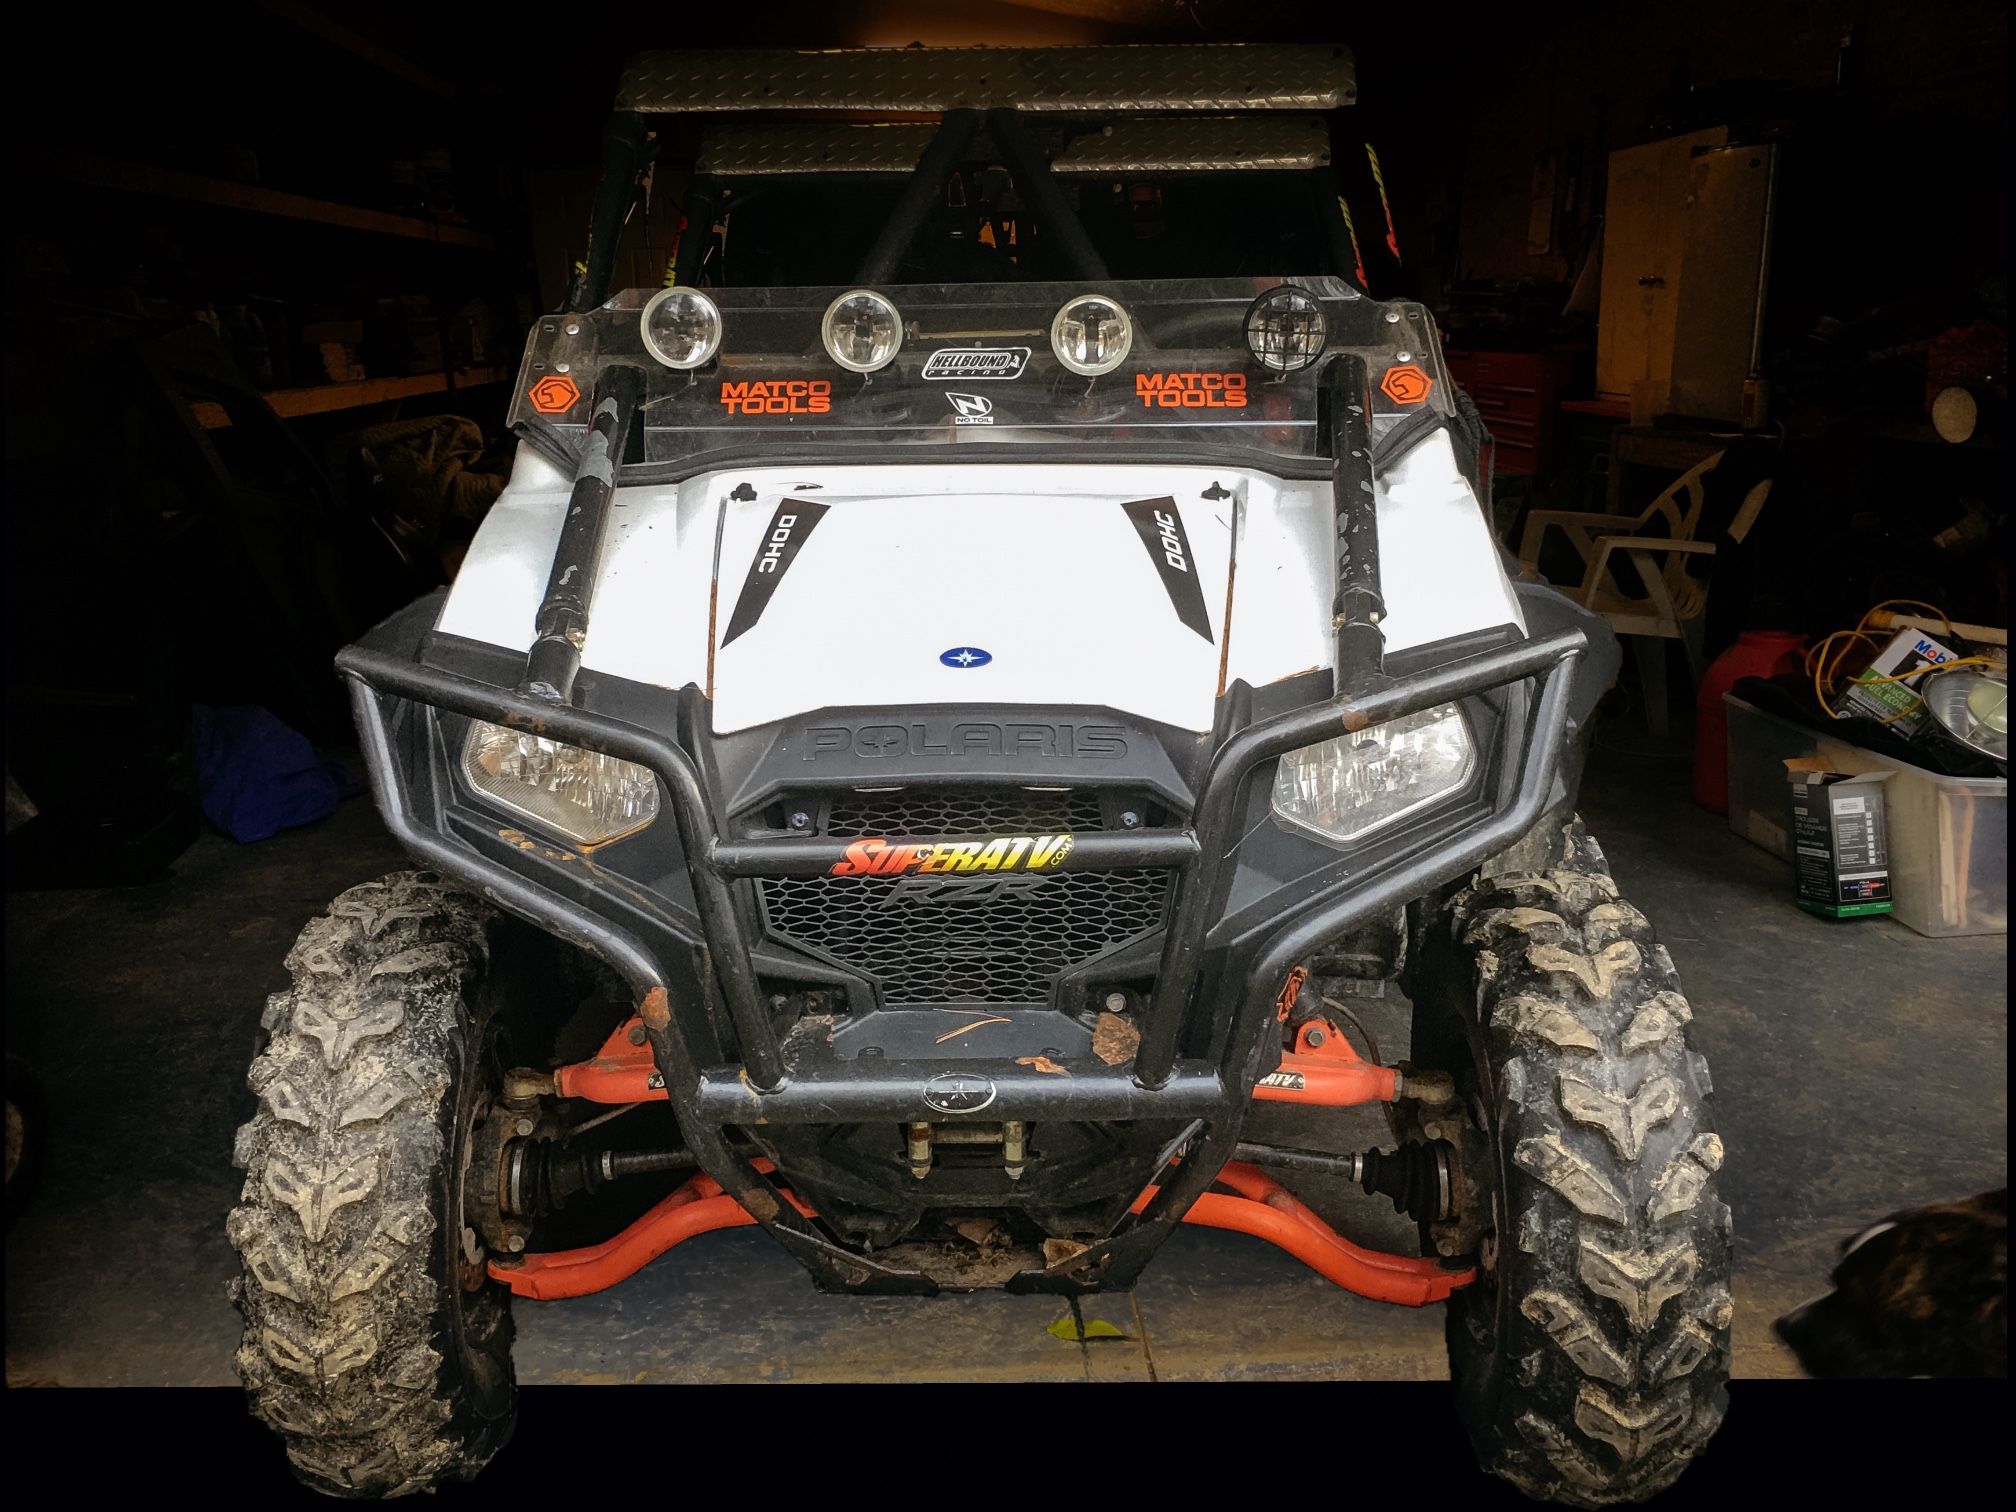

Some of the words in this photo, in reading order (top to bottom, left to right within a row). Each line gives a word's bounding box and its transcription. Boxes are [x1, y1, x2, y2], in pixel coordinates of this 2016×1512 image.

[931, 354, 1008, 369] HELLBOUND
[721, 380, 831, 398] MATCO
[1136, 373, 1246, 390] MATCO
[721, 397, 831, 415] TOOLS
[1136, 389, 1247, 408] TOOLS
[758, 514, 798, 574] DOHC
[1163, 510, 1188, 572] DOHC
[1914, 640, 1954, 664] Mob
[802, 723, 1128, 761] POLARIS
[831, 833, 1071, 876] SUPERATV
[878, 878, 1050, 911] RZR
